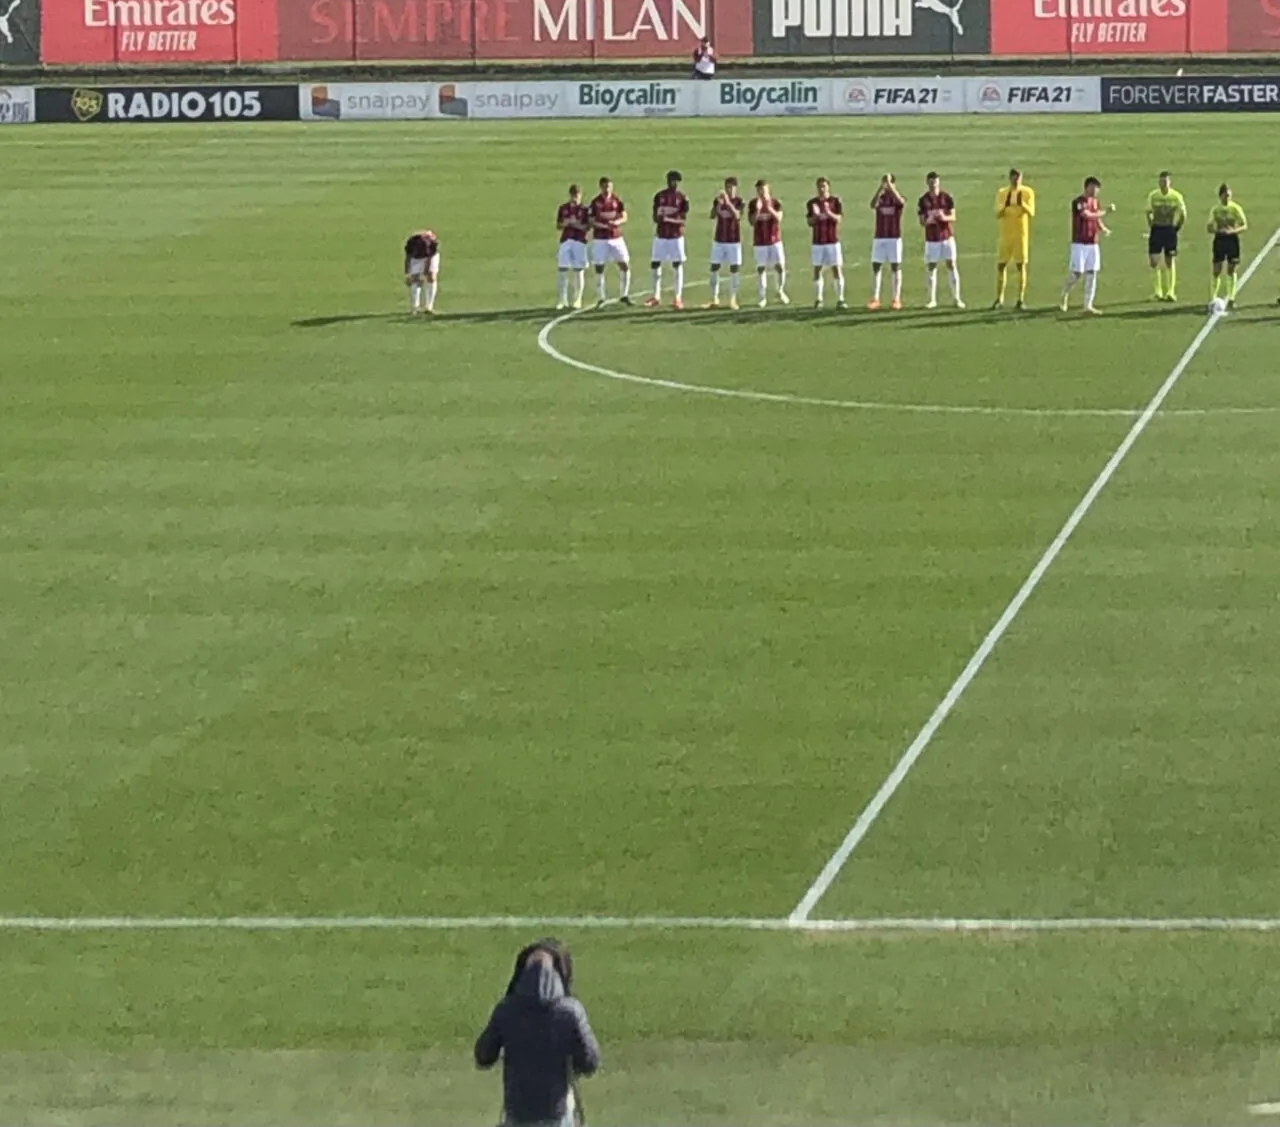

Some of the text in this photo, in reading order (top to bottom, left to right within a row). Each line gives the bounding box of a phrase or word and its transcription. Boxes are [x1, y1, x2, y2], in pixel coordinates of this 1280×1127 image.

[121, 30, 197, 52] FLY BETTER
[1071, 22, 1146, 43] FLY BETTER
[107, 91, 261, 119] RADIO 105
[348, 90, 430, 111] snaipay
[475, 88, 558, 109] snaipay
[873, 88, 916, 104] FIFA
[918, 87, 938, 103] 21
[1007, 86, 1050, 103] FIFA
[1051, 86, 1072, 103] 21
